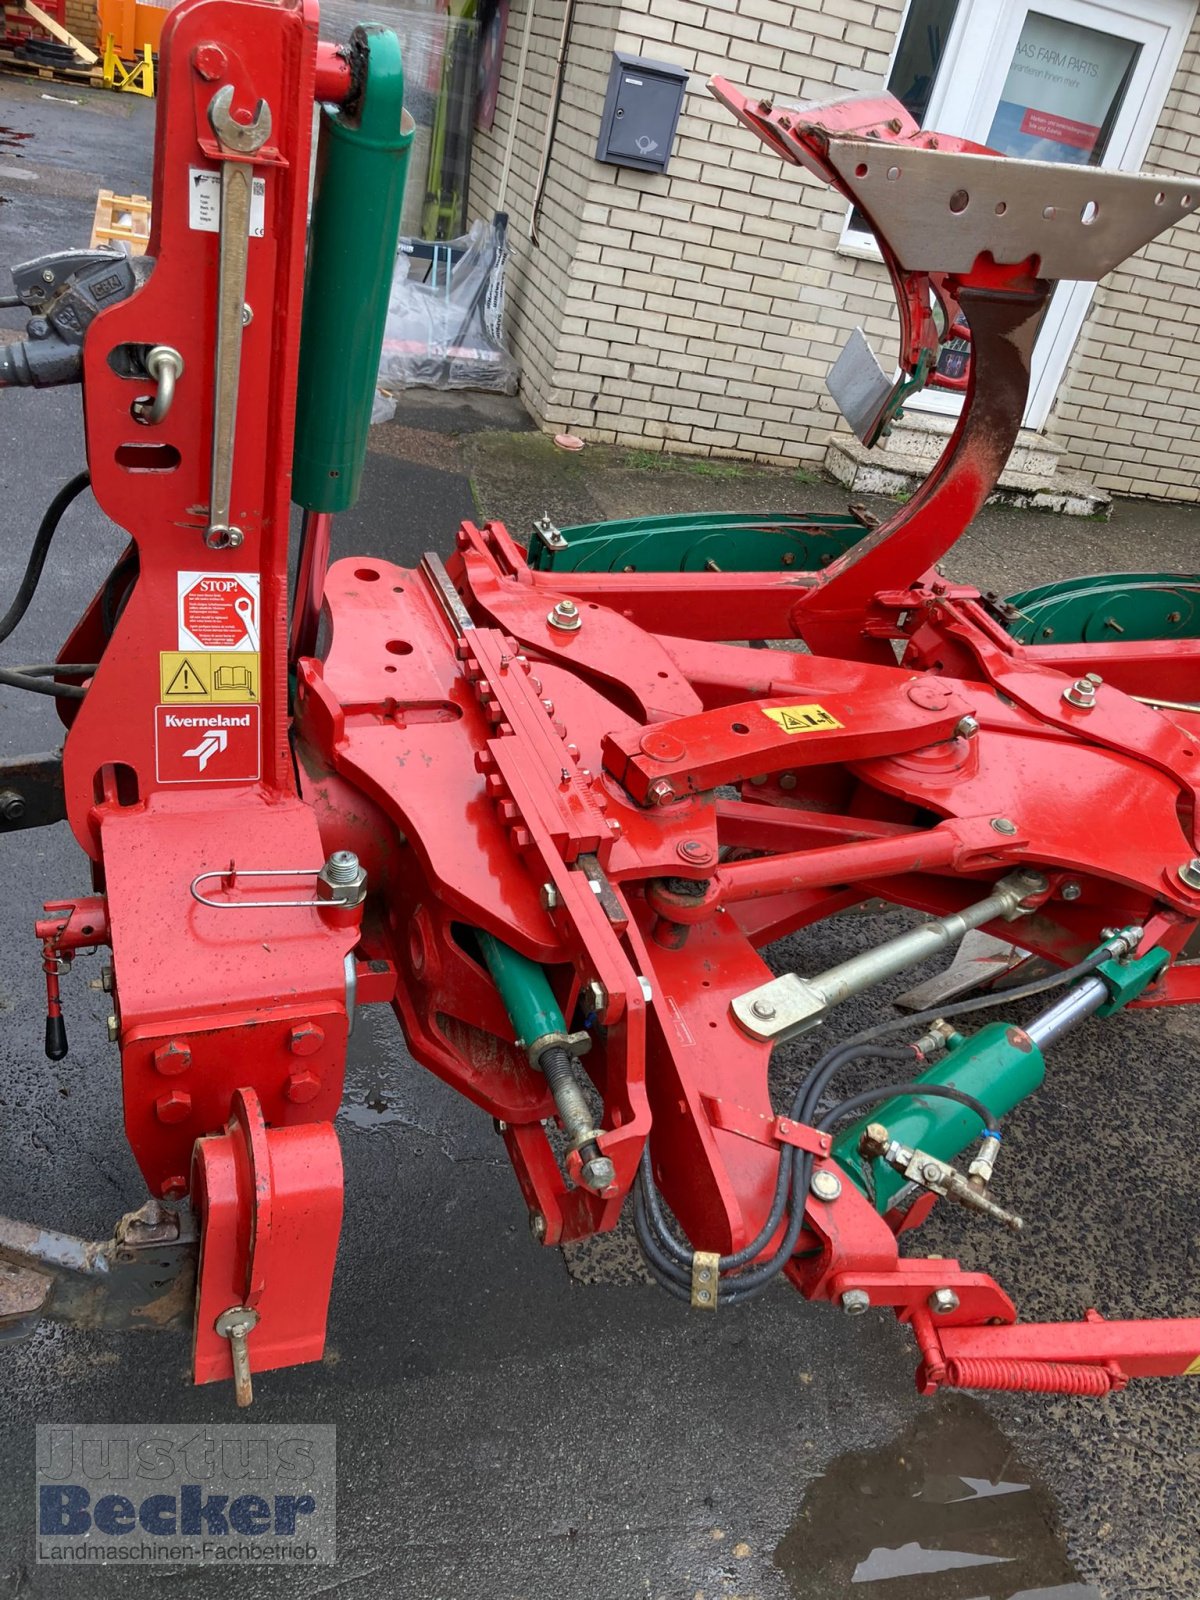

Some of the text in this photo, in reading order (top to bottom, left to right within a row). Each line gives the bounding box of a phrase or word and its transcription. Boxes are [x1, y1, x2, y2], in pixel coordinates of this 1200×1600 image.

[1037, 48, 1067, 67] FARM
[200, 580, 238, 593] STOP!
[165, 714, 250, 727] Kverneland
